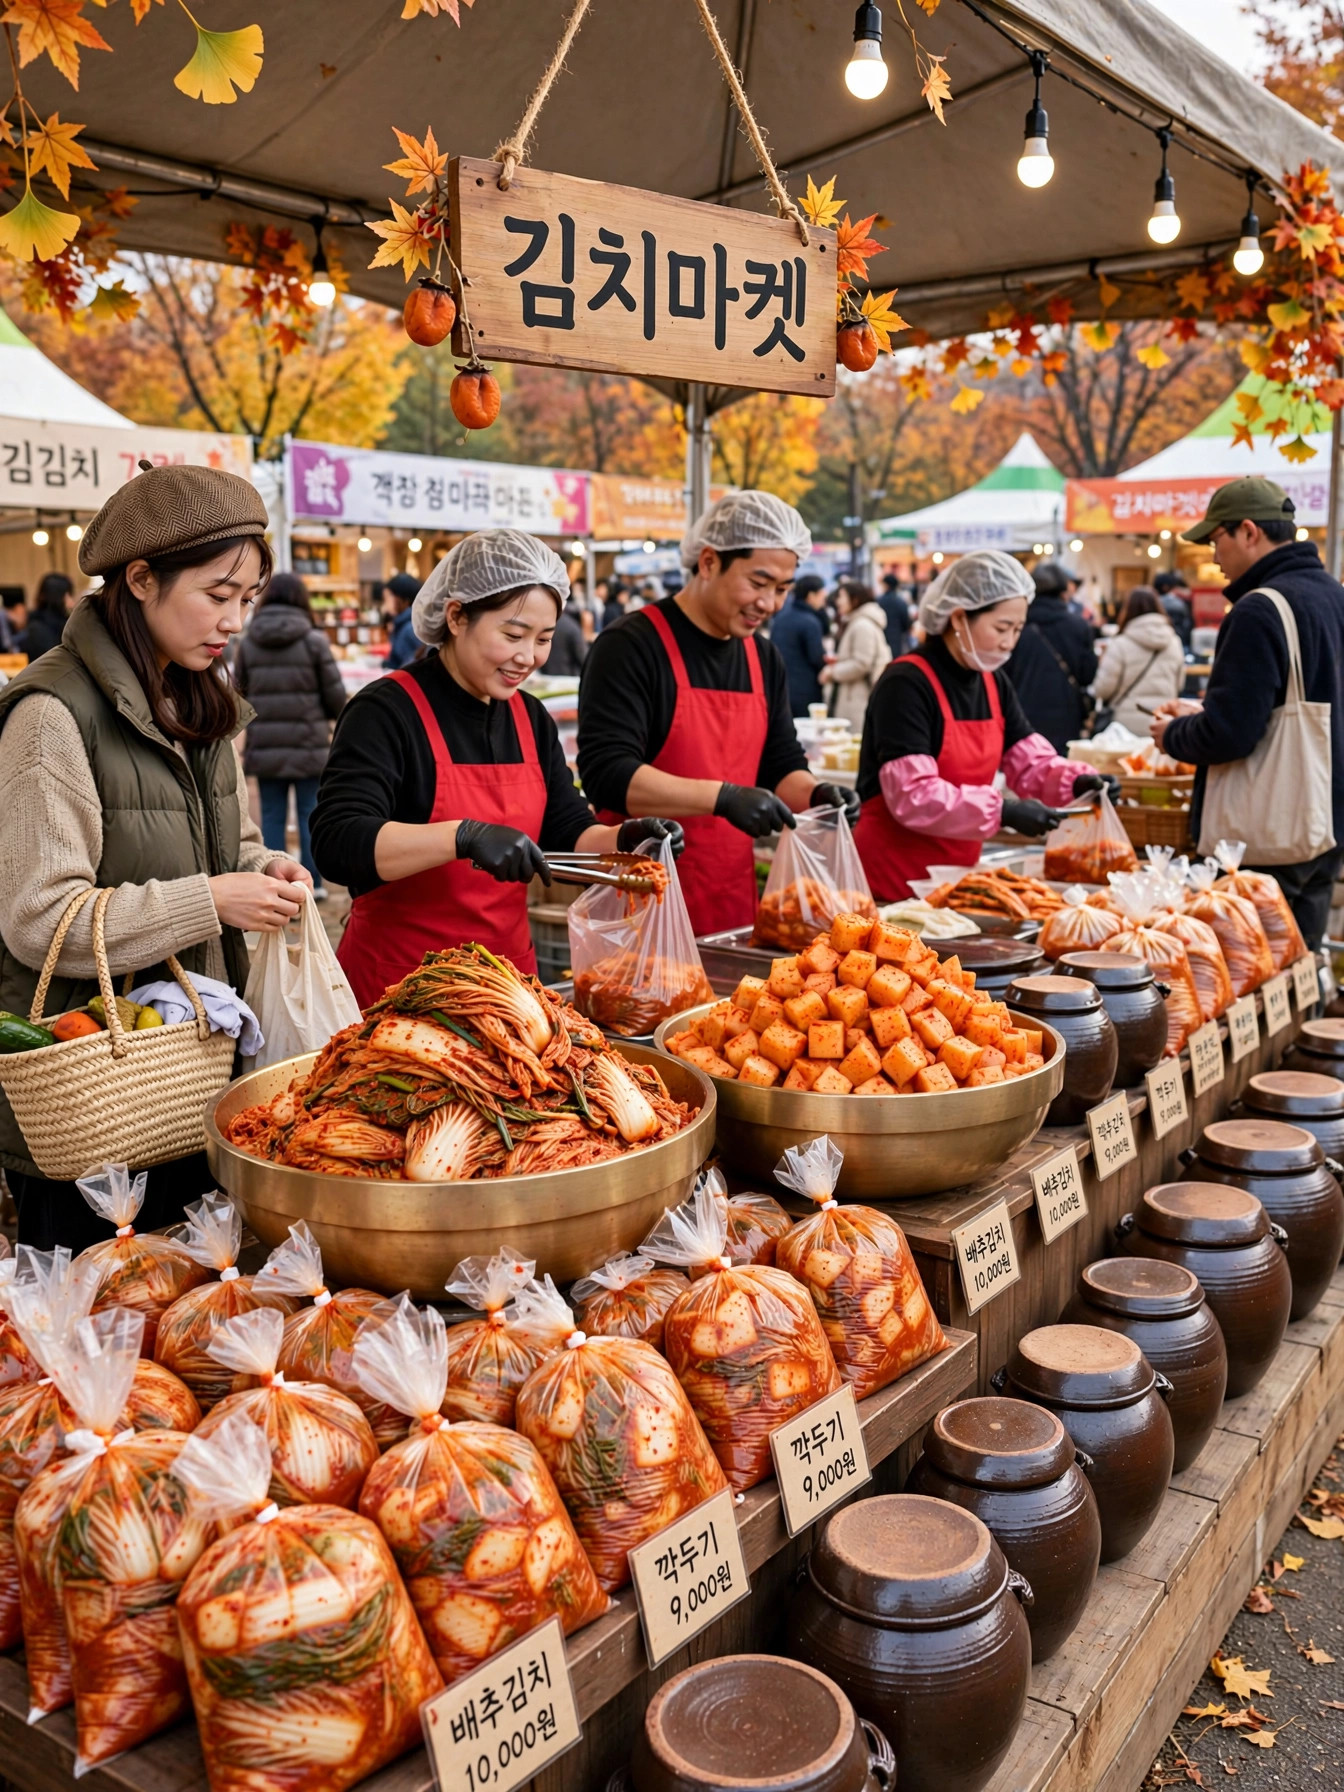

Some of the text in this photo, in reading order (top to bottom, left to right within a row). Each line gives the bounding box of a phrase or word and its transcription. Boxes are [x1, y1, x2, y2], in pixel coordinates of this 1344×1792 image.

[503, 213, 807, 363] 김치마켓
[3, 440, 100, 488] 김김치
[1104, 1137, 1131, 1164] 9,000원
[1041, 1163, 1075, 1197] 배추김치
[1049, 1191, 1081, 1225] 10,000원
[965, 1222, 1006, 1264] 배추김치
[974, 1251, 1012, 1293] 10,000원
[790, 1411, 845, 1465] 깍두기
[803, 1448, 857, 1503] 9,000원
[654, 1521, 719, 1584] 깍두기
[670, 1560, 733, 1625] 9,000원
[450, 1651, 552, 1744] 배추김치
[465, 1703, 558, 1792] 10,000원
